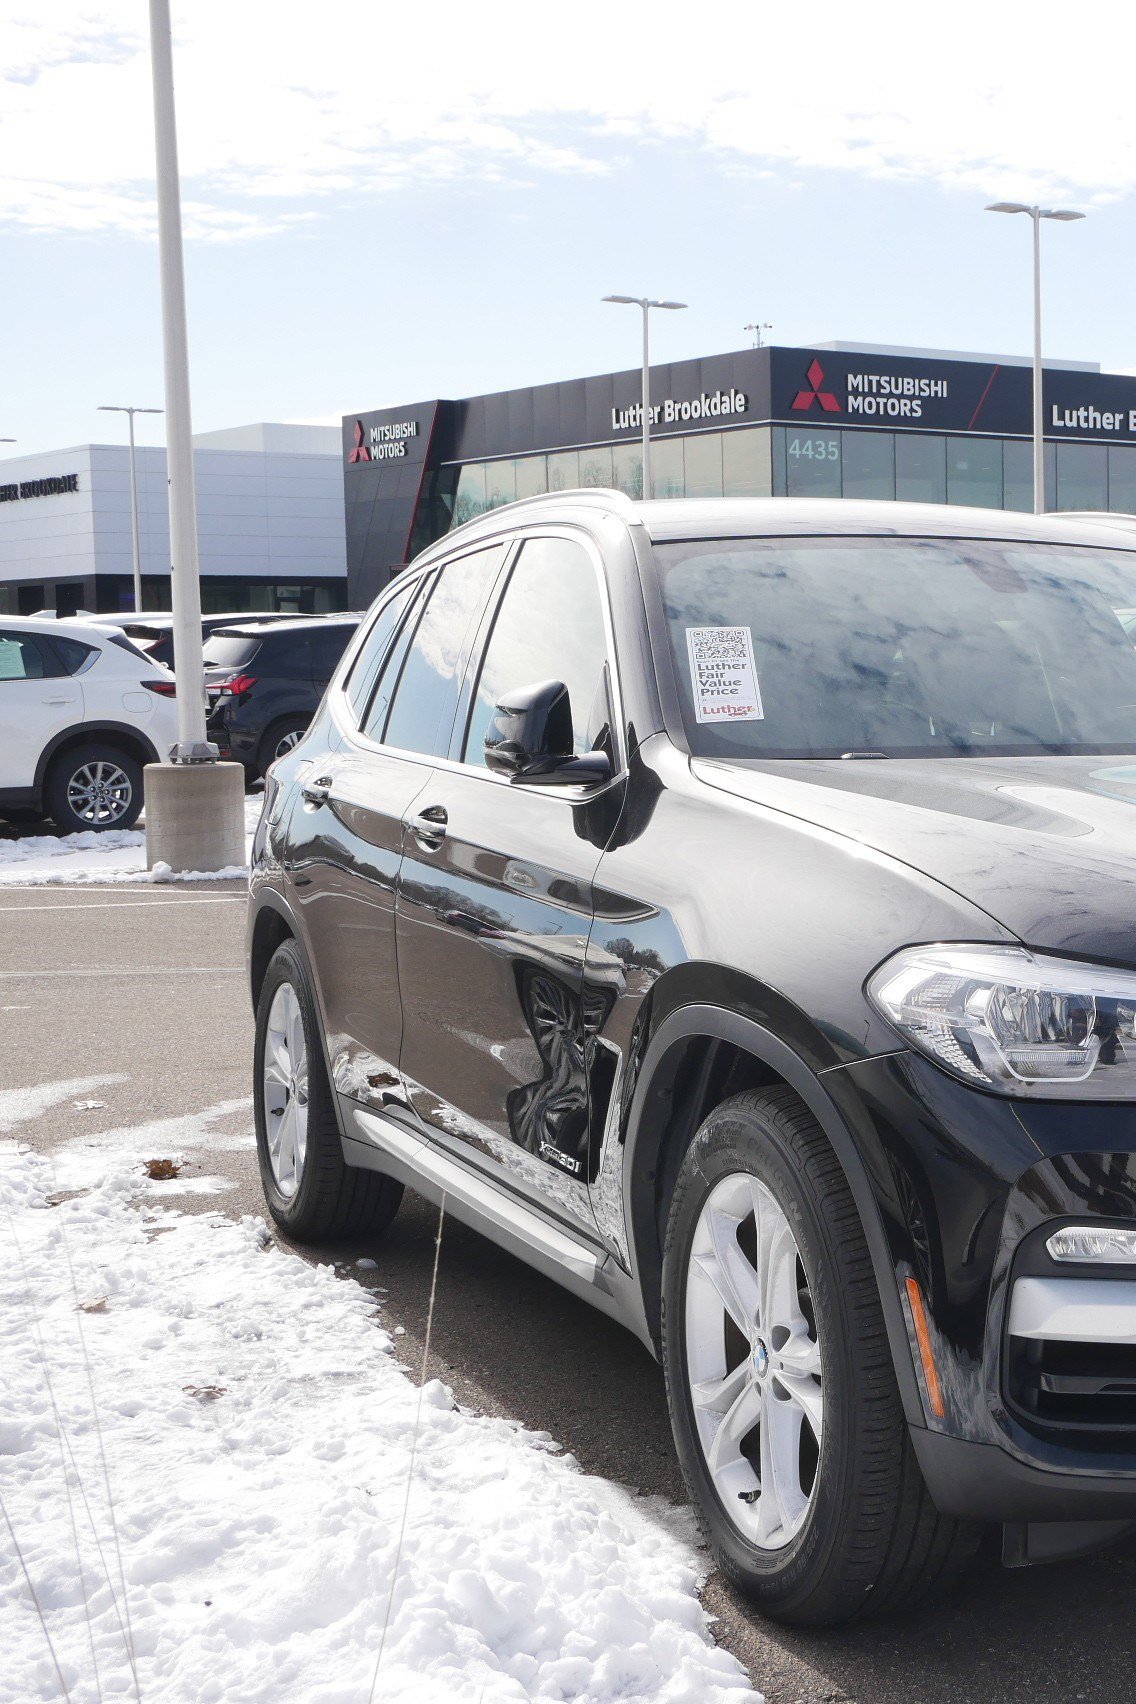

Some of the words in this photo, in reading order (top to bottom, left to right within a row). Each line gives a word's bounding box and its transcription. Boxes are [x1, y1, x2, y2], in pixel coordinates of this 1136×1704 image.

[847, 373, 948, 398] MITSUBISHI
[611, 403, 661, 430] Luther
[664, 388, 746, 423] Brookdale
[847, 395, 922, 418] MOTORS
[1052, 404, 1124, 431] Luther
[370, 421, 418, 443] MITSUBISHI
[371, 441, 406, 461] MOTORS
[789, 438, 839, 461] 4435
[697, 662, 747, 671] Luther
[699, 670, 726, 679] Fair
[699, 679, 743, 687] Value
[701, 687, 739, 696] Price
[702, 704, 753, 715] Luther
